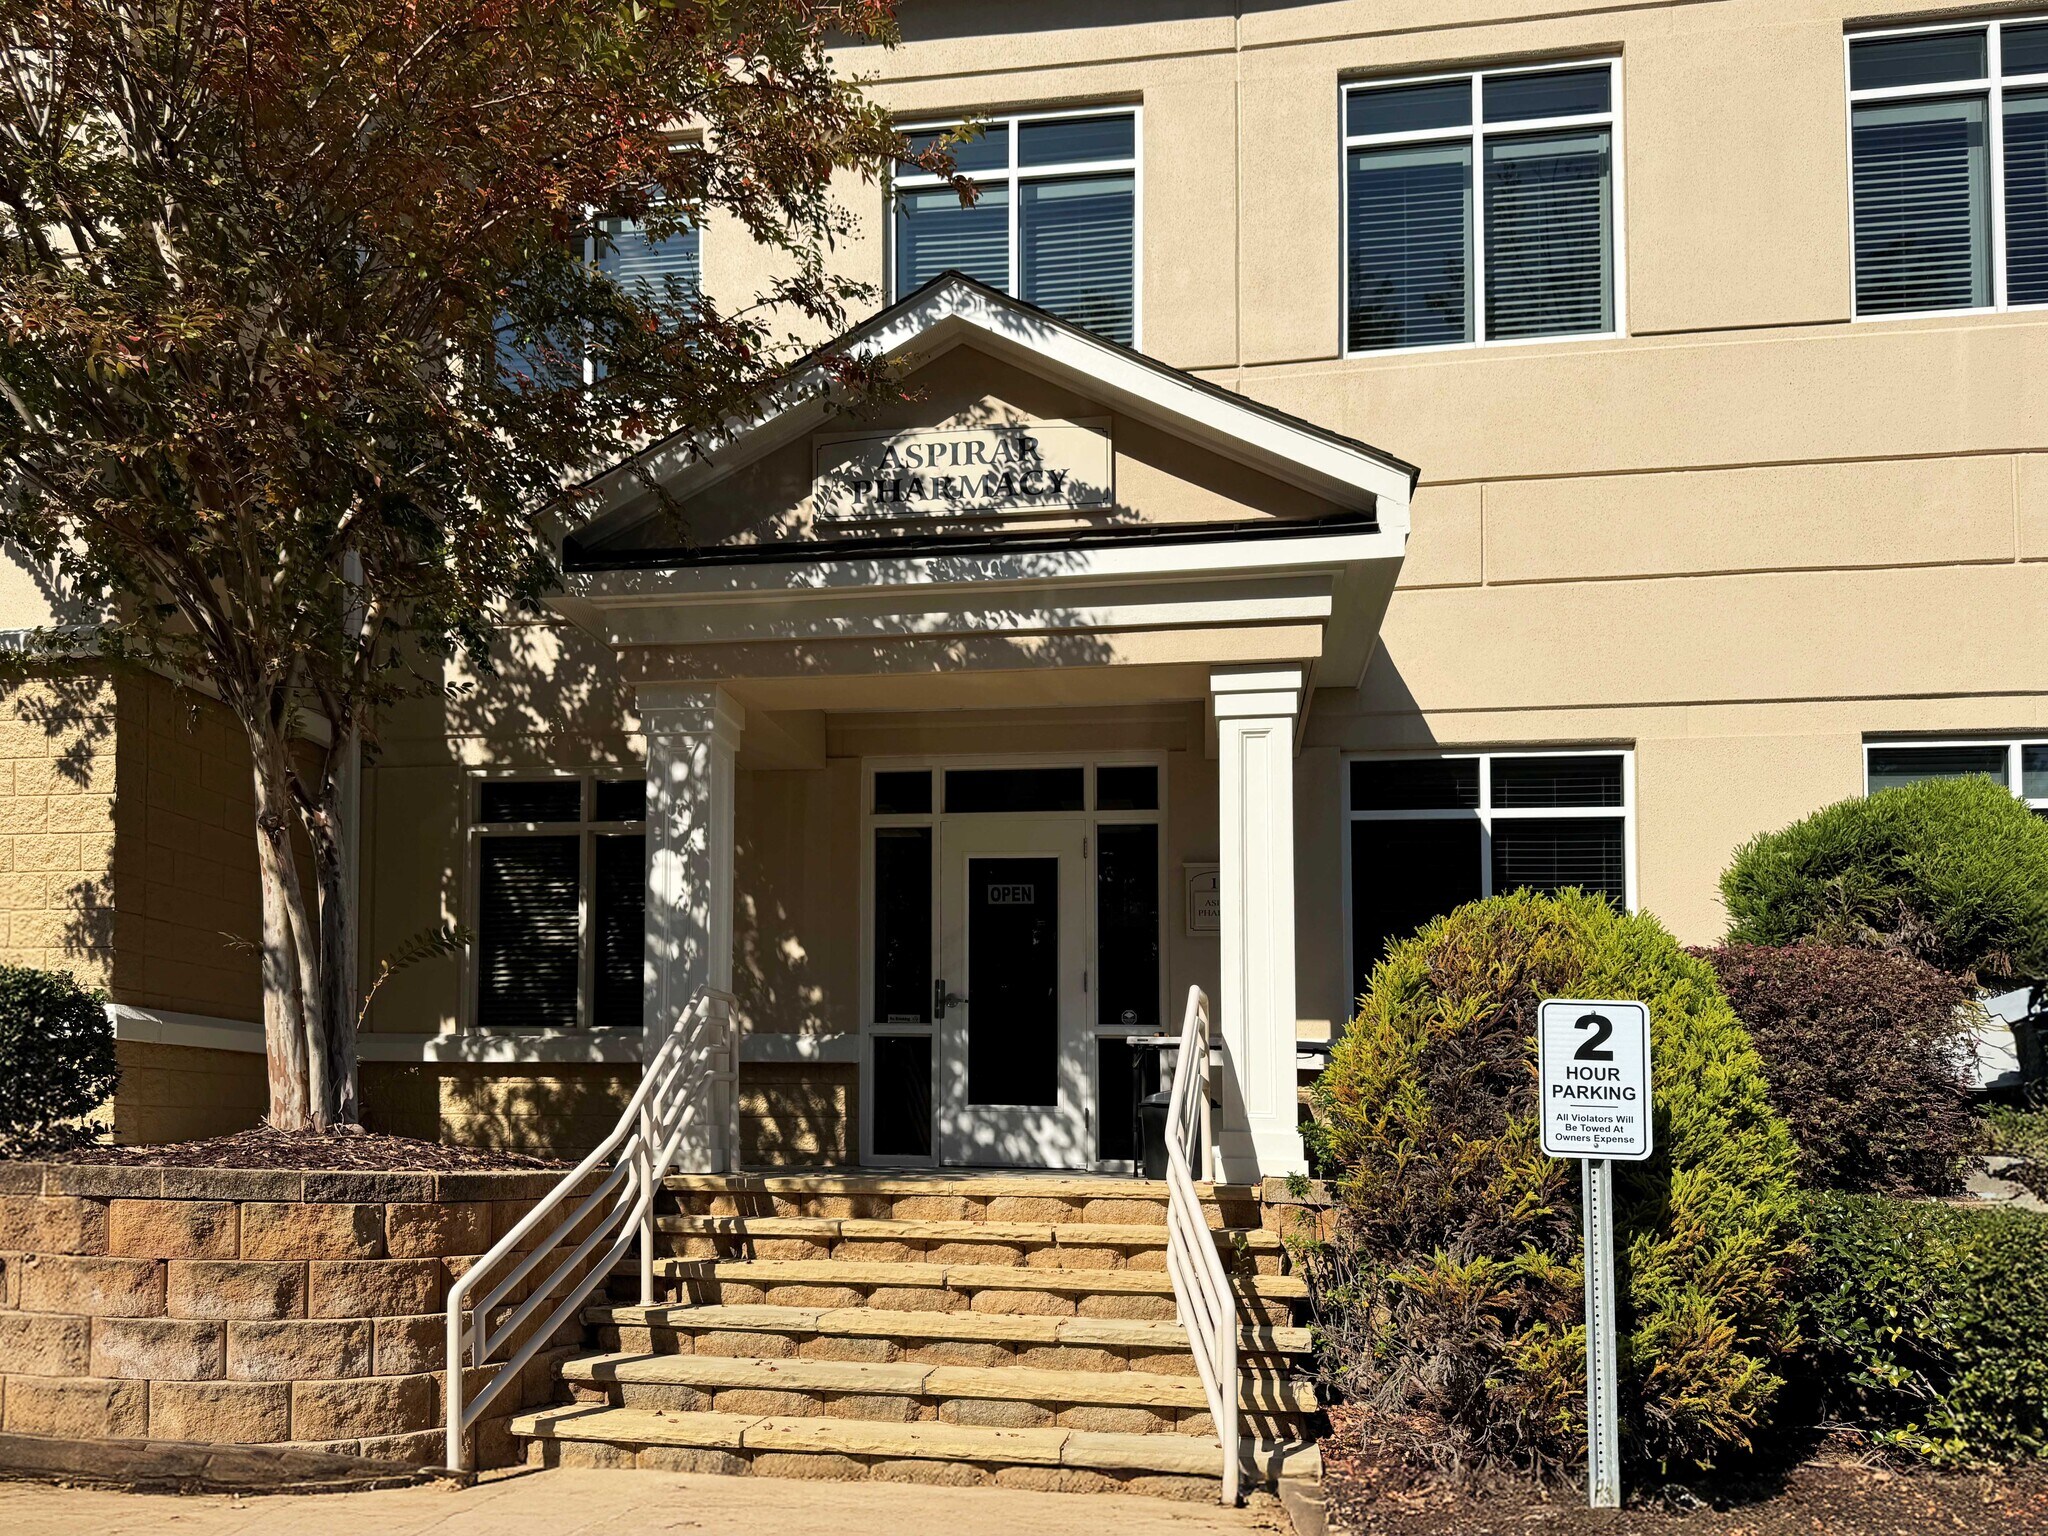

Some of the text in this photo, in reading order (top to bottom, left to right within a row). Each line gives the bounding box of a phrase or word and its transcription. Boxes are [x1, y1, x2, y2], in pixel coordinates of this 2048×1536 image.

[877, 436, 1044, 471] ASPIRAR
[850, 466, 1072, 505] PHARMACY
[990, 886, 1032, 902] OPEN
[1573, 1014, 1614, 1062] 2
[1566, 1066, 1621, 1081] HOUR
[1552, 1084, 1636, 1101] PARKING
[1556, 1113, 1634, 1123] All Violators Will
[1565, 1123, 1624, 1133] Be Towed At
[1555, 1133, 1635, 1144] Owners Expense
